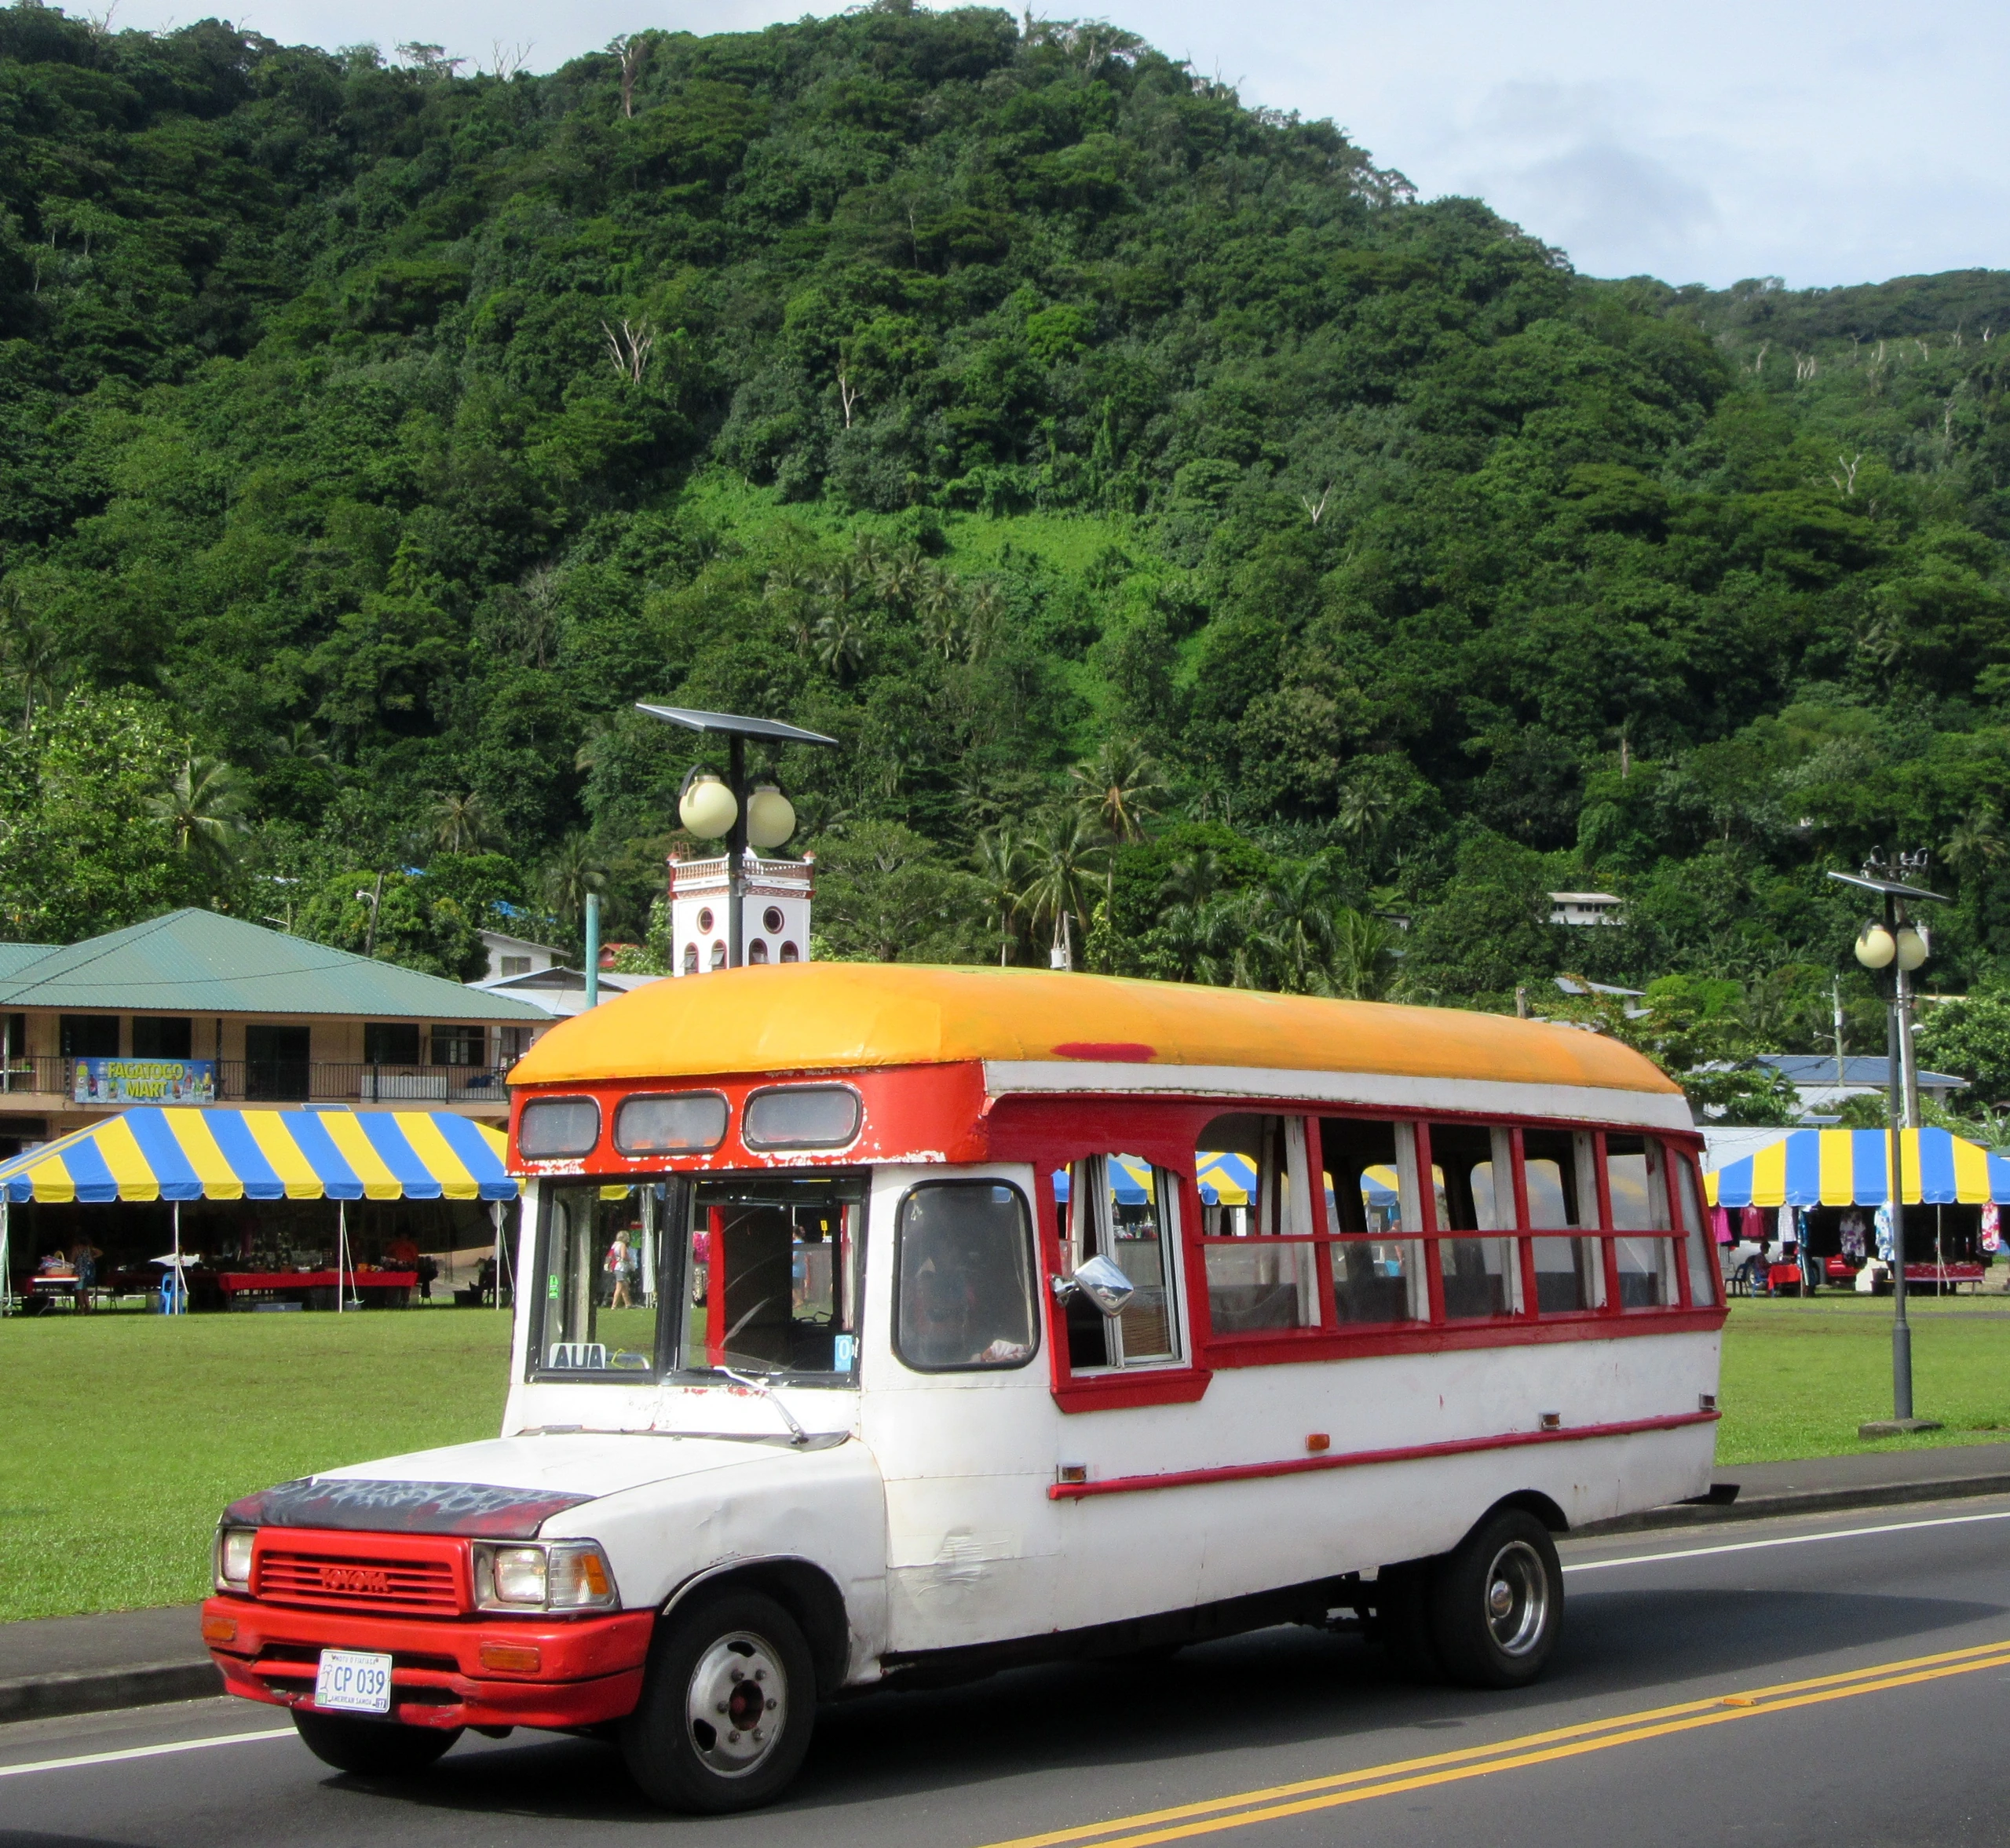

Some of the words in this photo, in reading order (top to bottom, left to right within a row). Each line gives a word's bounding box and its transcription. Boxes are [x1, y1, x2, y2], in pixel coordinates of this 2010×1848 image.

[108, 1061, 185, 1080] FAGATOGO
[126, 1080, 167, 1097] MART
[554, 1345, 603, 1368] AUA
[320, 1569, 389, 1592] TOYOTA
[334, 1666, 353, 1692] CP
[356, 1668, 386, 1695] 039
[331, 1695, 355, 1704] AMERICAN
